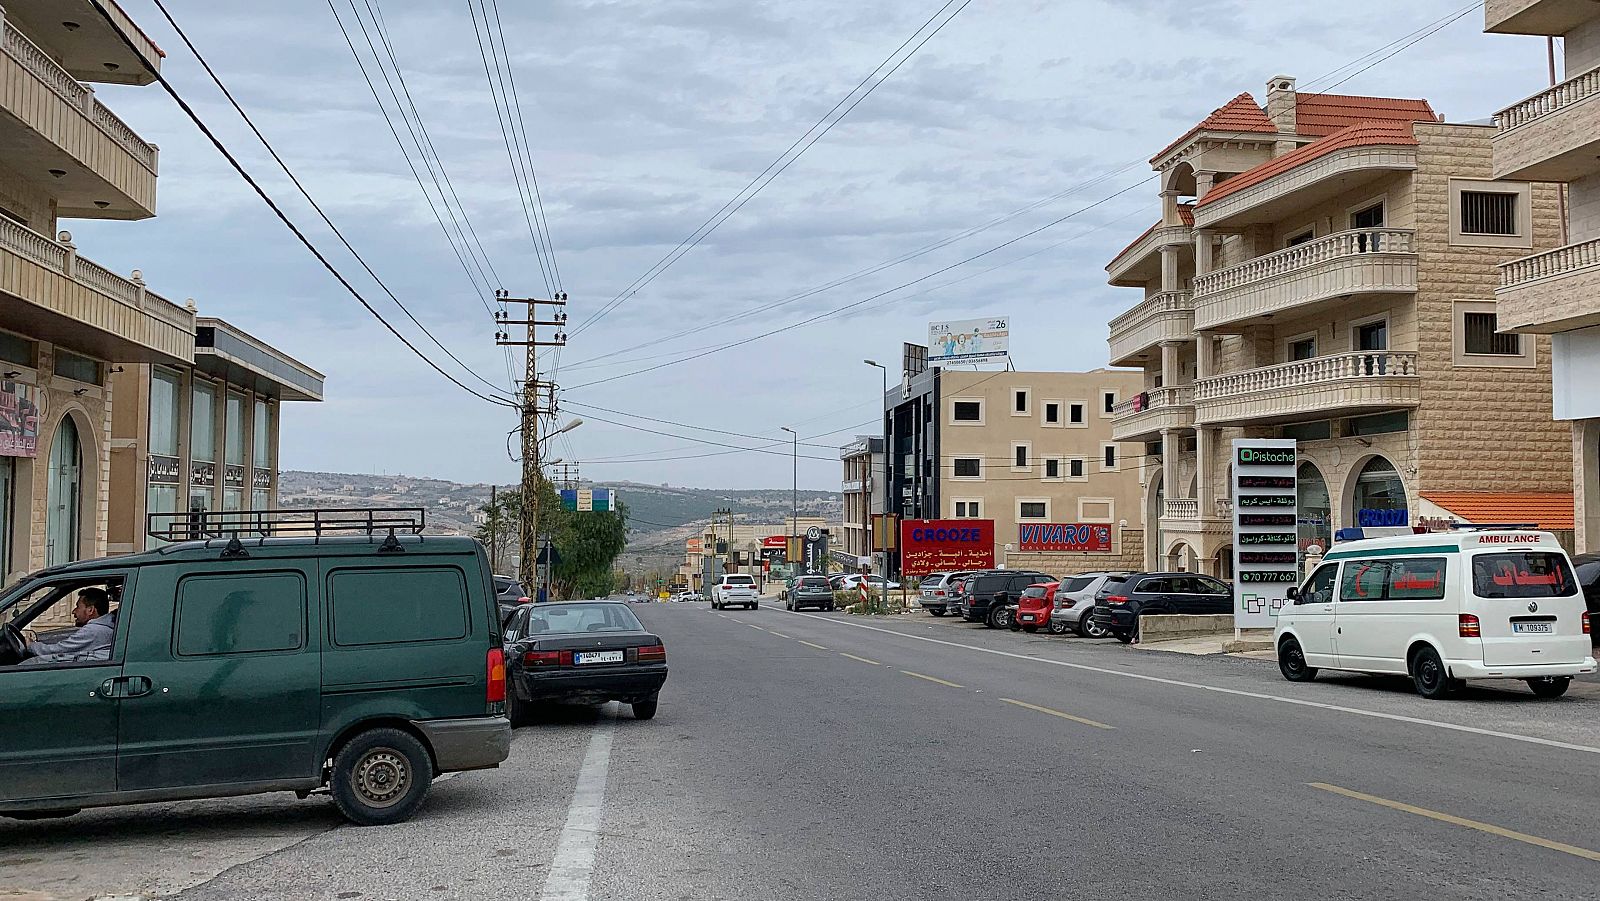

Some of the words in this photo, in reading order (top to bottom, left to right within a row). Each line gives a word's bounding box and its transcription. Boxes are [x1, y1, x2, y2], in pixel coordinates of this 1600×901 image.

[996, 320, 1006, 329] 26
[1252, 451, 1295, 462] Pistache
[1241, 497, 1258, 506] كريم
[912, 527, 981, 542] CROOZE
[1021, 524, 1091, 545] VIVARO
[1478, 535, 1541, 544] AMBULANCE
[1250, 572, 1261, 581] 70
[1262, 572, 1278, 581] 777
[1279, 572, 1296, 581] 667
[1493, 564, 1564, 592] إسعاف
